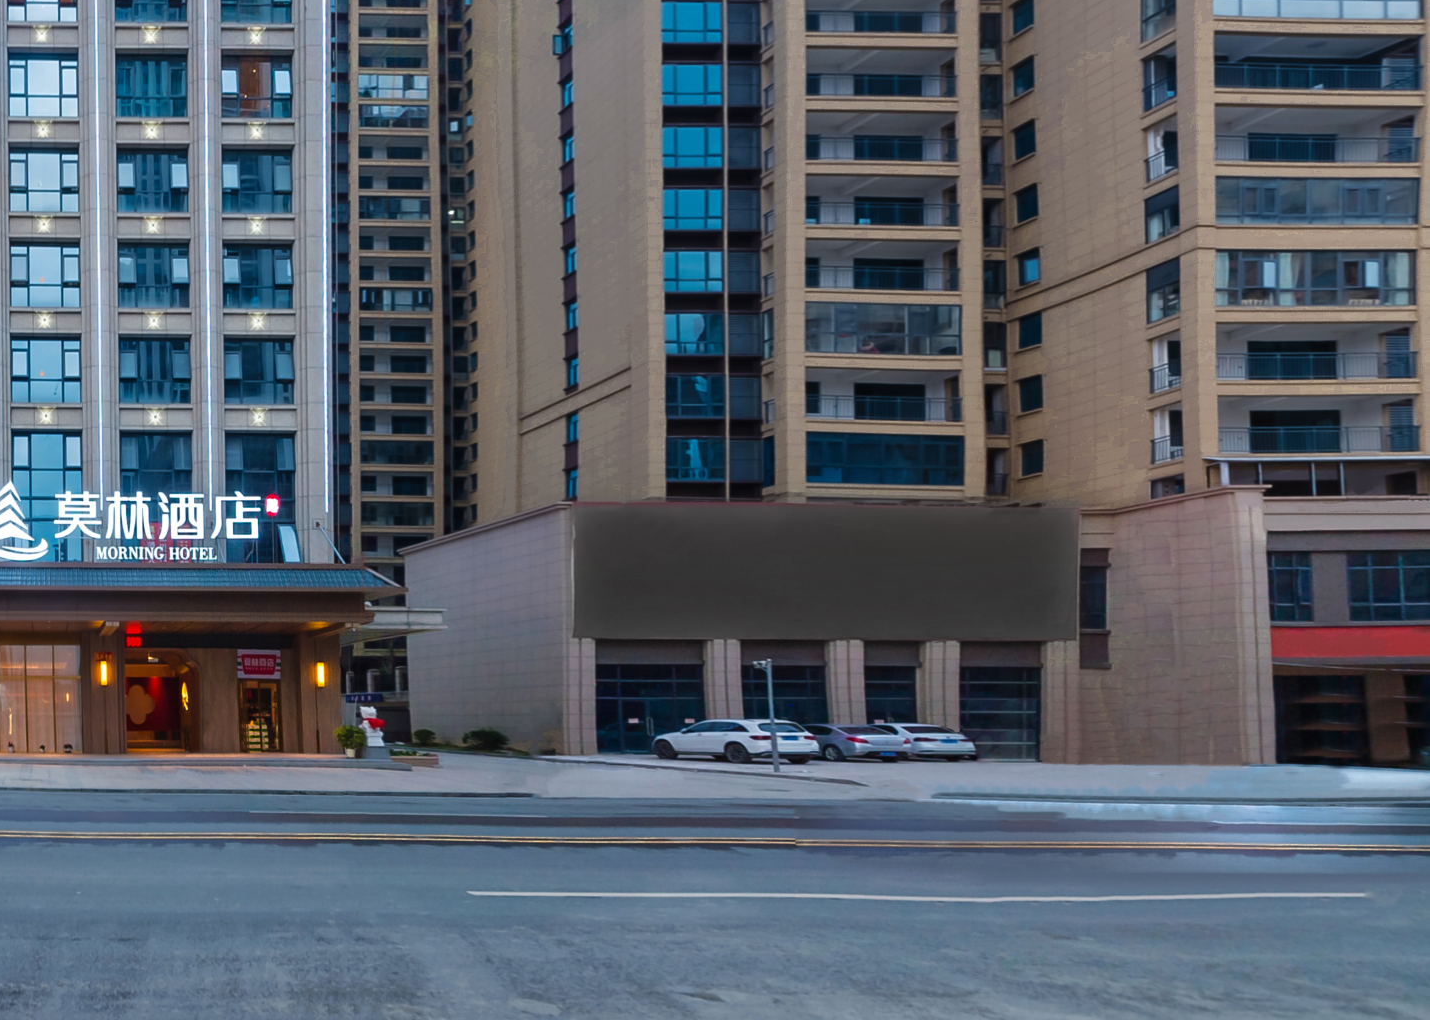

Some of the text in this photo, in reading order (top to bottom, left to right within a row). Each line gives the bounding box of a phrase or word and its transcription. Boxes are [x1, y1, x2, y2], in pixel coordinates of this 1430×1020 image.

[53, 490, 262, 540] 莫林酒店
[95, 546, 218, 561] MORNING HOTEL
